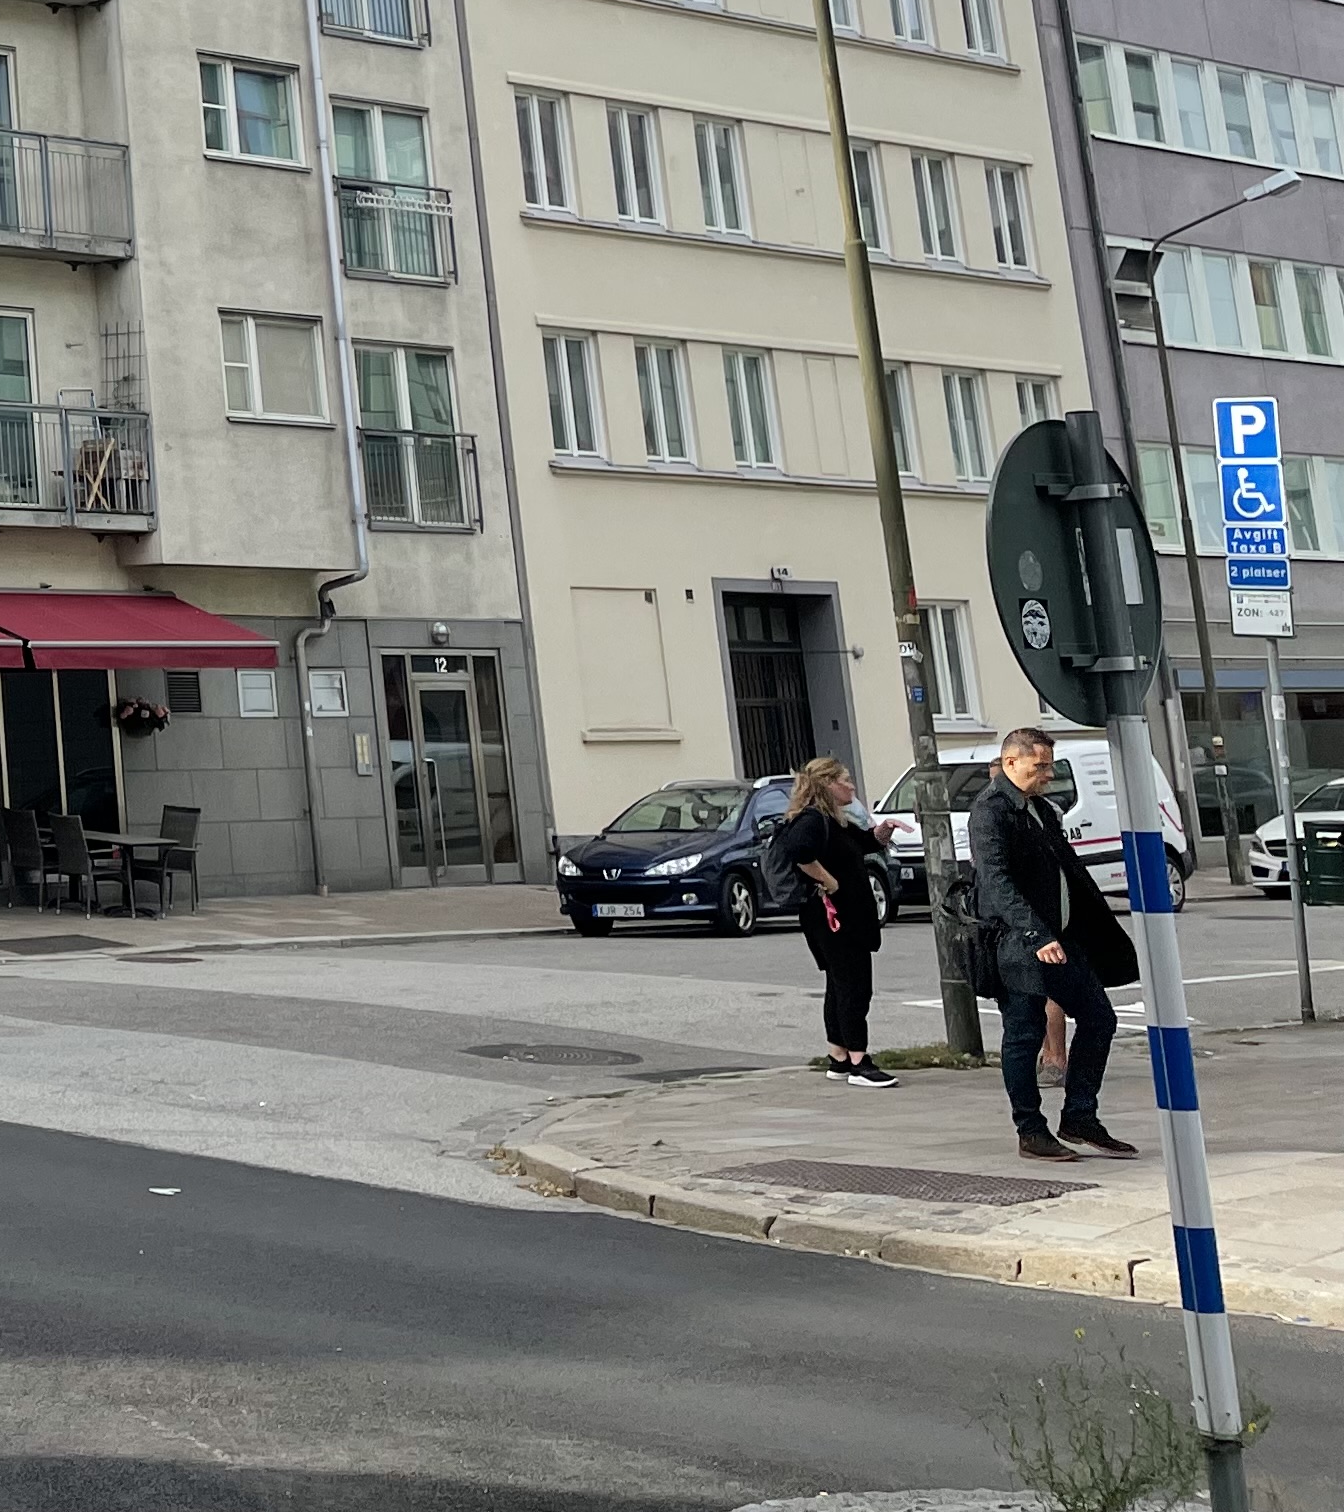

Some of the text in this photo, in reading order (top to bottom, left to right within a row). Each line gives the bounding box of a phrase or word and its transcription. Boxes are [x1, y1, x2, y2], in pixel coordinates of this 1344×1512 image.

[1230, 405, 1267, 455] P
[1233, 528, 1278, 542] Avgift
[1231, 541, 1282, 554] Taxa B
[776, 567, 789, 576] 14
[1230, 566, 1286, 580] 2 platser
[434, 657, 448, 673] 12
